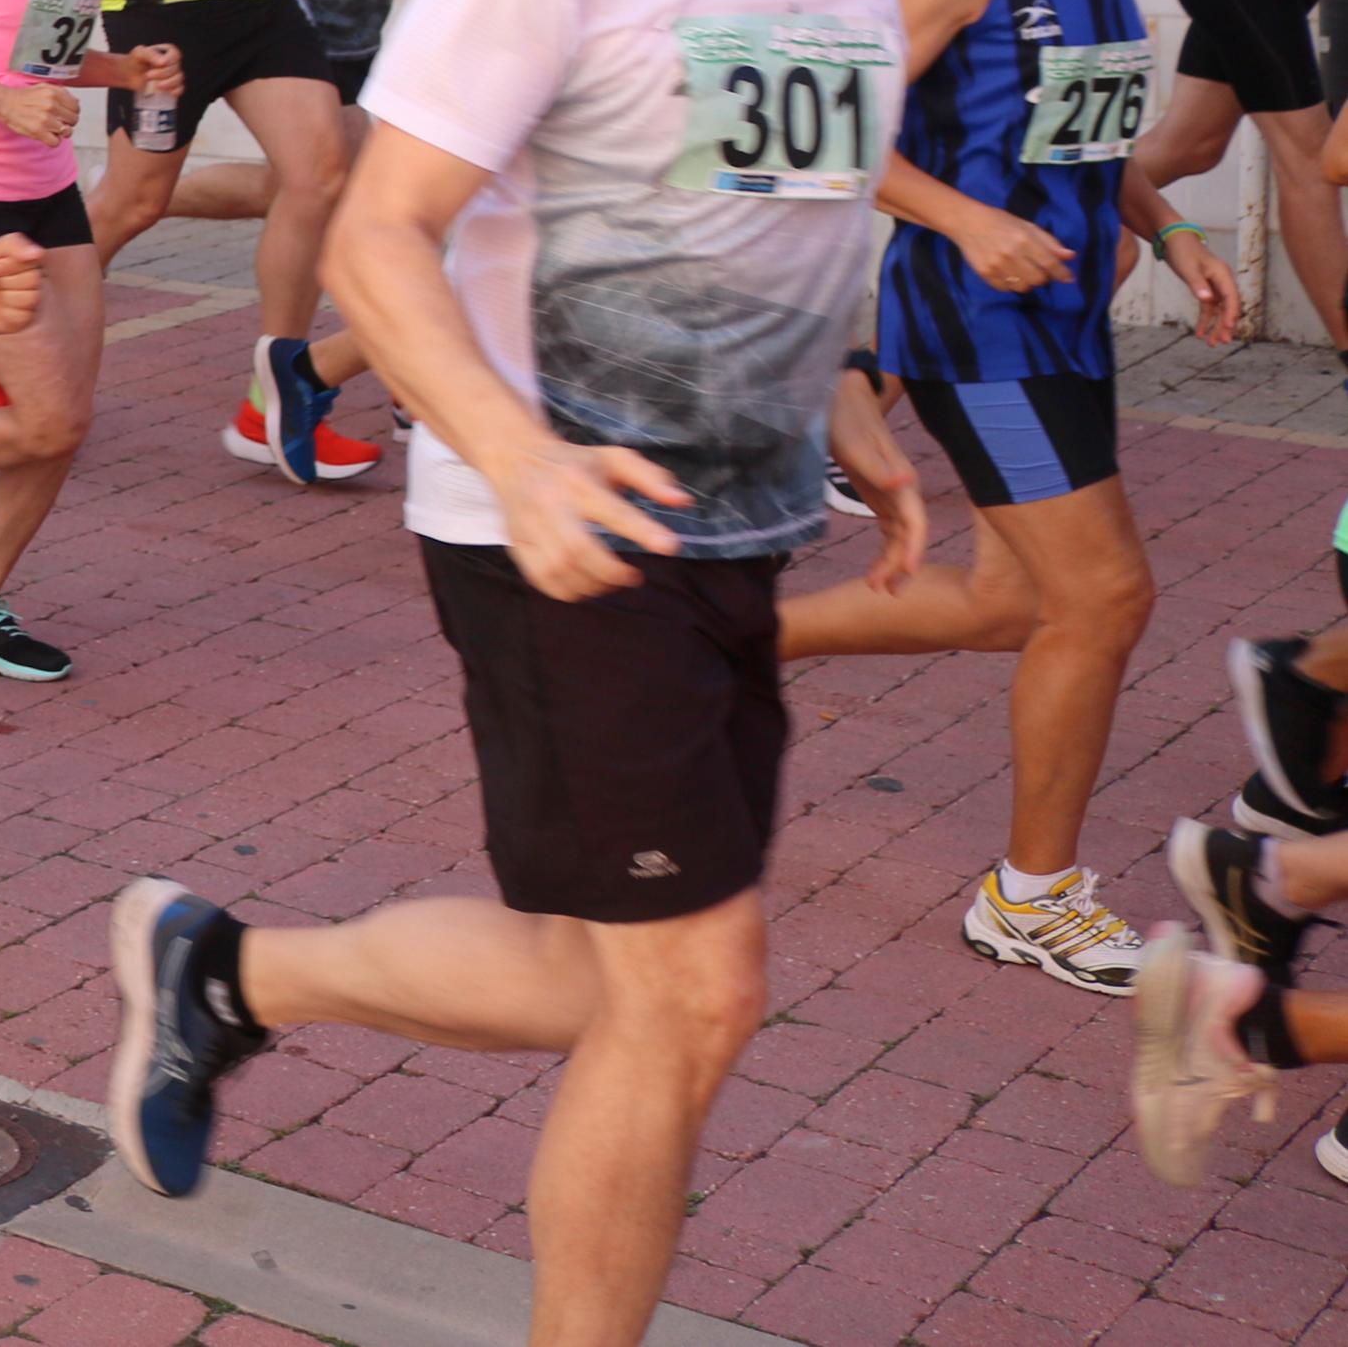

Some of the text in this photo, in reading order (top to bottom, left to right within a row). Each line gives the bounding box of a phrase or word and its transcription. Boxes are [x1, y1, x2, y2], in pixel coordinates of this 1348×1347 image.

[41, 16, 94, 65] 32
[721, 65, 863, 170] 301
[1049, 73, 1146, 145] 276
